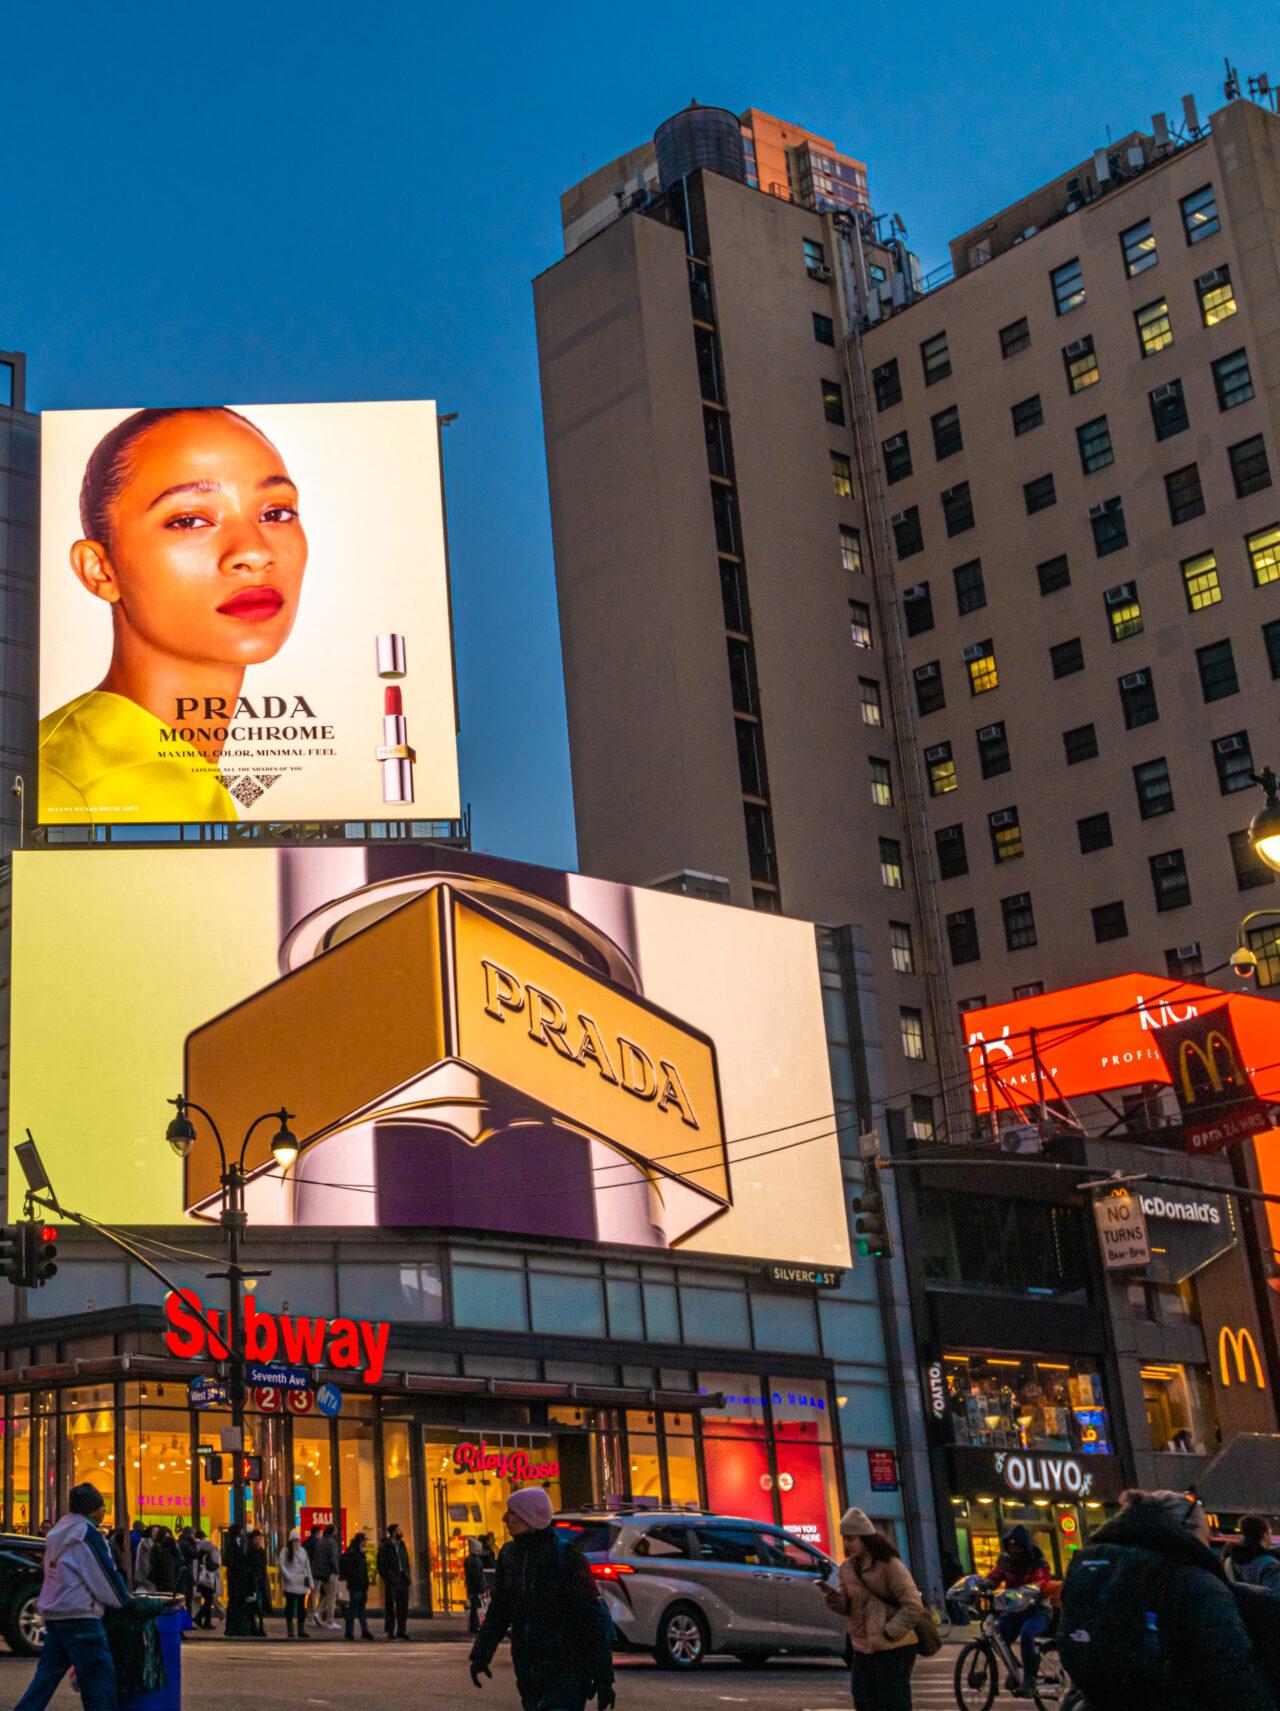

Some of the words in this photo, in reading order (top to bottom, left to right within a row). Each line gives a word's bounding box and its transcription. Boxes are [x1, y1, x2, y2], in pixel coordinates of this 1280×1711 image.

[175, 695, 317, 720] PRADA
[159, 725, 335, 742] MONOCHROME
[158, 750, 213, 758] MAXIMAL
[213, 749, 254, 757] COLOR,
[256, 748, 307, 757] MINIMAL
[308, 748, 337, 756] FEEL
[481, 960, 699, 1130] PRADA
[1101, 1048, 1160, 1067] PROFES
[1192, 1129, 1222, 1147] OPEN
[1241, 1113, 1266, 1130] HRS
[1107, 1205, 1130, 1223] NO
[1140, 1195, 1220, 1224] cDonald's
[1104, 1227, 1143, 1243] TURNS
[774, 1267, 835, 1285] SILVERCAST
[164, 1288, 391, 1385] Subway
[251, 1370, 287, 1384] Seventh
[288, 1375, 306, 1386] Ave
[929, 1366, 945, 1411] OLIYO
[191, 1389, 207, 1401] West
[261, 1386, 275, 1408] 2
[294, 1389, 307, 1409] 3
[319, 1386, 338, 1410] MTA
[454, 1440, 507, 1479] Riley
[509, 1451, 560, 1482] Rose
[1007, 1457, 1081, 1492] OLIYO
[802, 1524, 817, 1534] YOU
[802, 1533, 821, 1543] HERE
